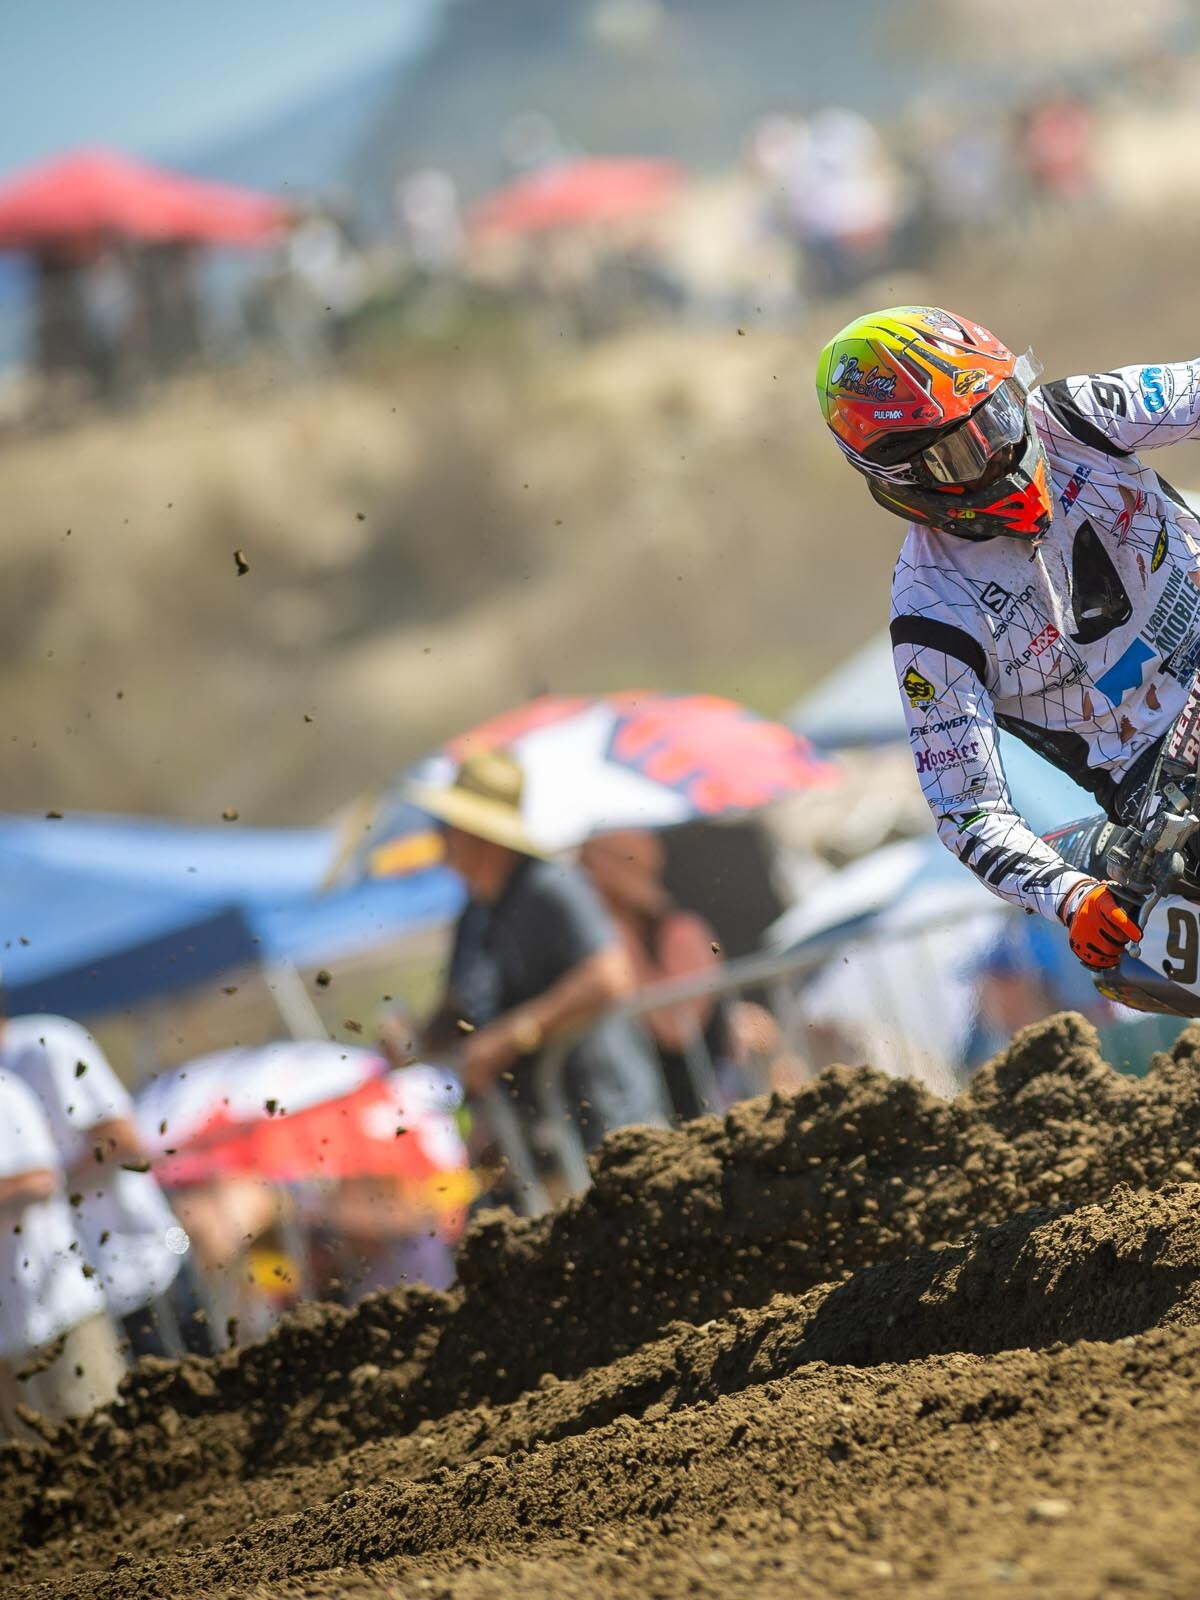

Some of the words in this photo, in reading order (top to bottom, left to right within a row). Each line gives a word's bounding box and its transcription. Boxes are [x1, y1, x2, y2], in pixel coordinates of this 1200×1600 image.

[1140, 564, 1184, 643] LIGHTNING
[1154, 576, 1200, 653] MOBILE
[915, 741, 979, 773] Hoosier
